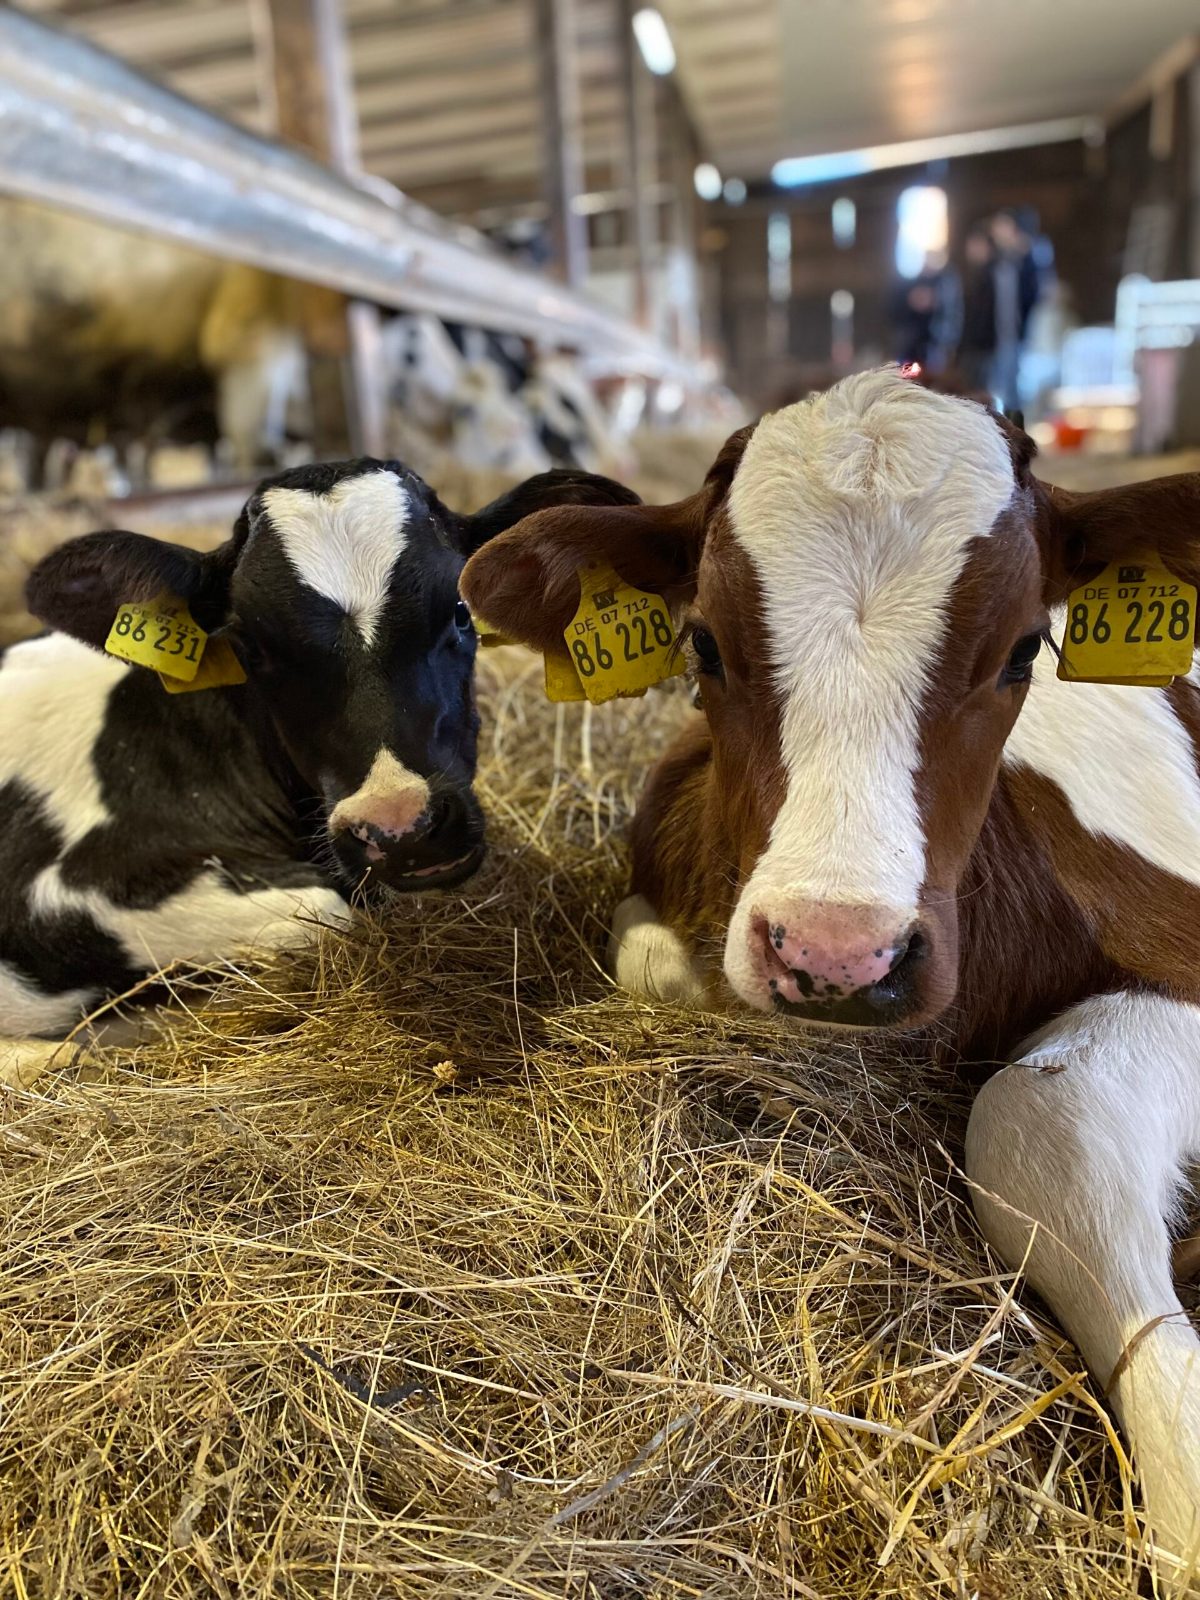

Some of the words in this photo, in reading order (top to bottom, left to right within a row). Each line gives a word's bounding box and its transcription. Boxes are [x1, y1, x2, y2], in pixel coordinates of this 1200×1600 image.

[1083, 588, 1110, 600] DE
[1117, 588, 1140, 599] 07
[1147, 585, 1179, 598] 712
[115, 612, 148, 641] 86
[153, 626, 200, 662] 231
[573, 617, 597, 635] DE
[600, 609, 618, 625] 07
[623, 597, 650, 615] 712
[1069, 602, 1112, 645] 86
[1124, 599, 1190, 643] 228
[572, 631, 614, 677] 86
[615, 609, 673, 662] 228
